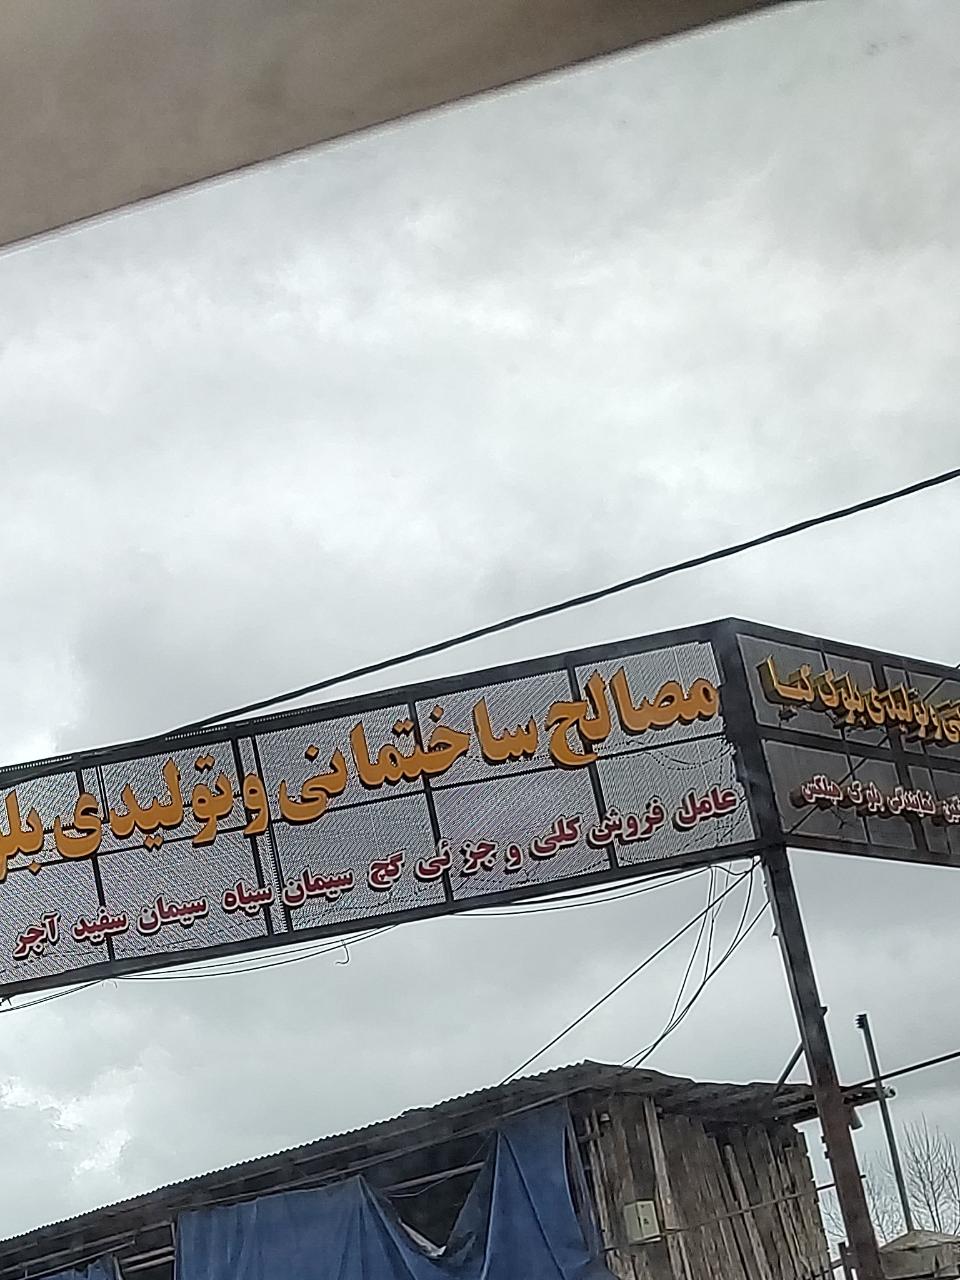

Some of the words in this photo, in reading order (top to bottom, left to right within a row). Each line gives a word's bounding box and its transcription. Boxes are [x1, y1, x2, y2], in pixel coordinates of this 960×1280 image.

[547, 667, 720, 769] مصالح
[278, 698, 539, 823] ساختمانی
[53, 754, 235, 859] تولیدی
[239, 772, 268, 836] و
[590, 798, 666, 844] فروش
[677, 785, 739, 827] عامل
[506, 842, 522, 871] و
[533, 816, 582, 856] کلی
[284, 867, 355, 907] سیمان
[369, 851, 405, 889] گچ
[137, 894, 208, 932] سیمان
[222, 880, 274, 913] سیاه
[13, 911, 61, 957] آجر
[73, 908, 130, 943] سفید
